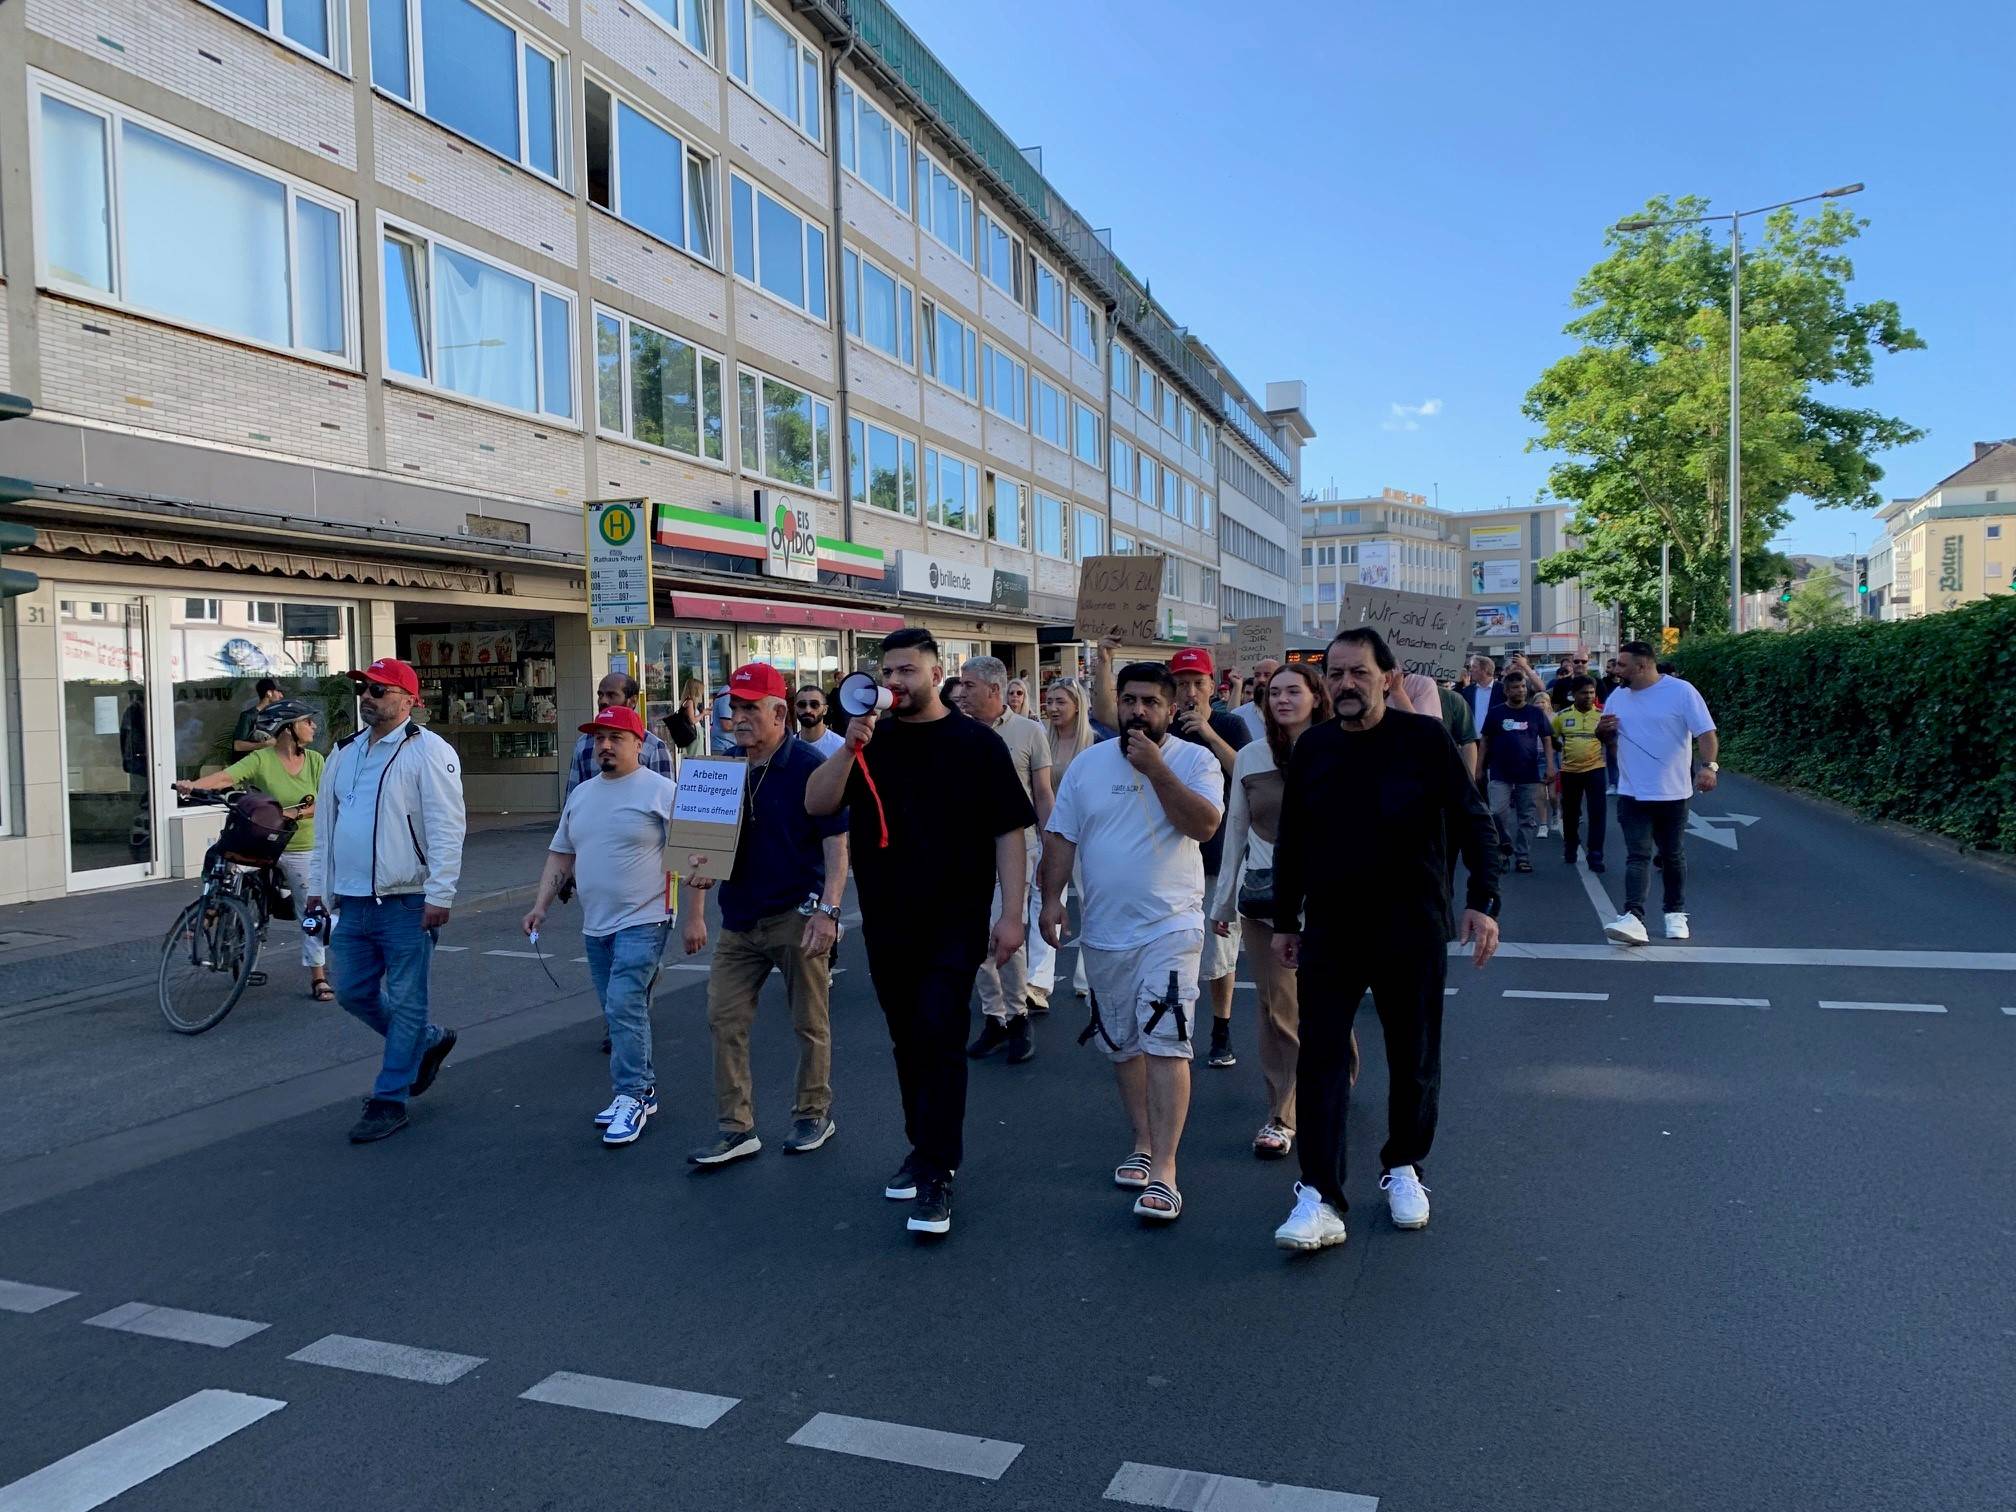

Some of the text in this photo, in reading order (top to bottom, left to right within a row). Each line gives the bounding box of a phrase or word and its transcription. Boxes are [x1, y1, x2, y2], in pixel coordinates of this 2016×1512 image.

[609, 512, 625, 537] H
[797, 510, 809, 530] EIS
[620, 555, 643, 563] Rheydt
[939, 567, 971, 590] brillen.de
[1083, 559, 1131, 592] Kiosk
[619, 592, 629, 601] 097
[28, 606, 45, 623] 31
[615, 615, 634, 624] NEW
[1368, 598, 1447, 630] Wir sind für
[1243, 625, 1272, 635] Gönn
[1387, 628, 1437, 650] Menschen
[1240, 644, 1266, 652] auch
[464, 665, 514, 677] WAFFEL
[693, 769, 728, 781] Arbeiten
[680, 784, 738, 797] statt Bürgergeld
[681, 803, 697, 812] lasst
[697, 805, 710, 814] uns
[710, 806, 737, 816] öffnen!
